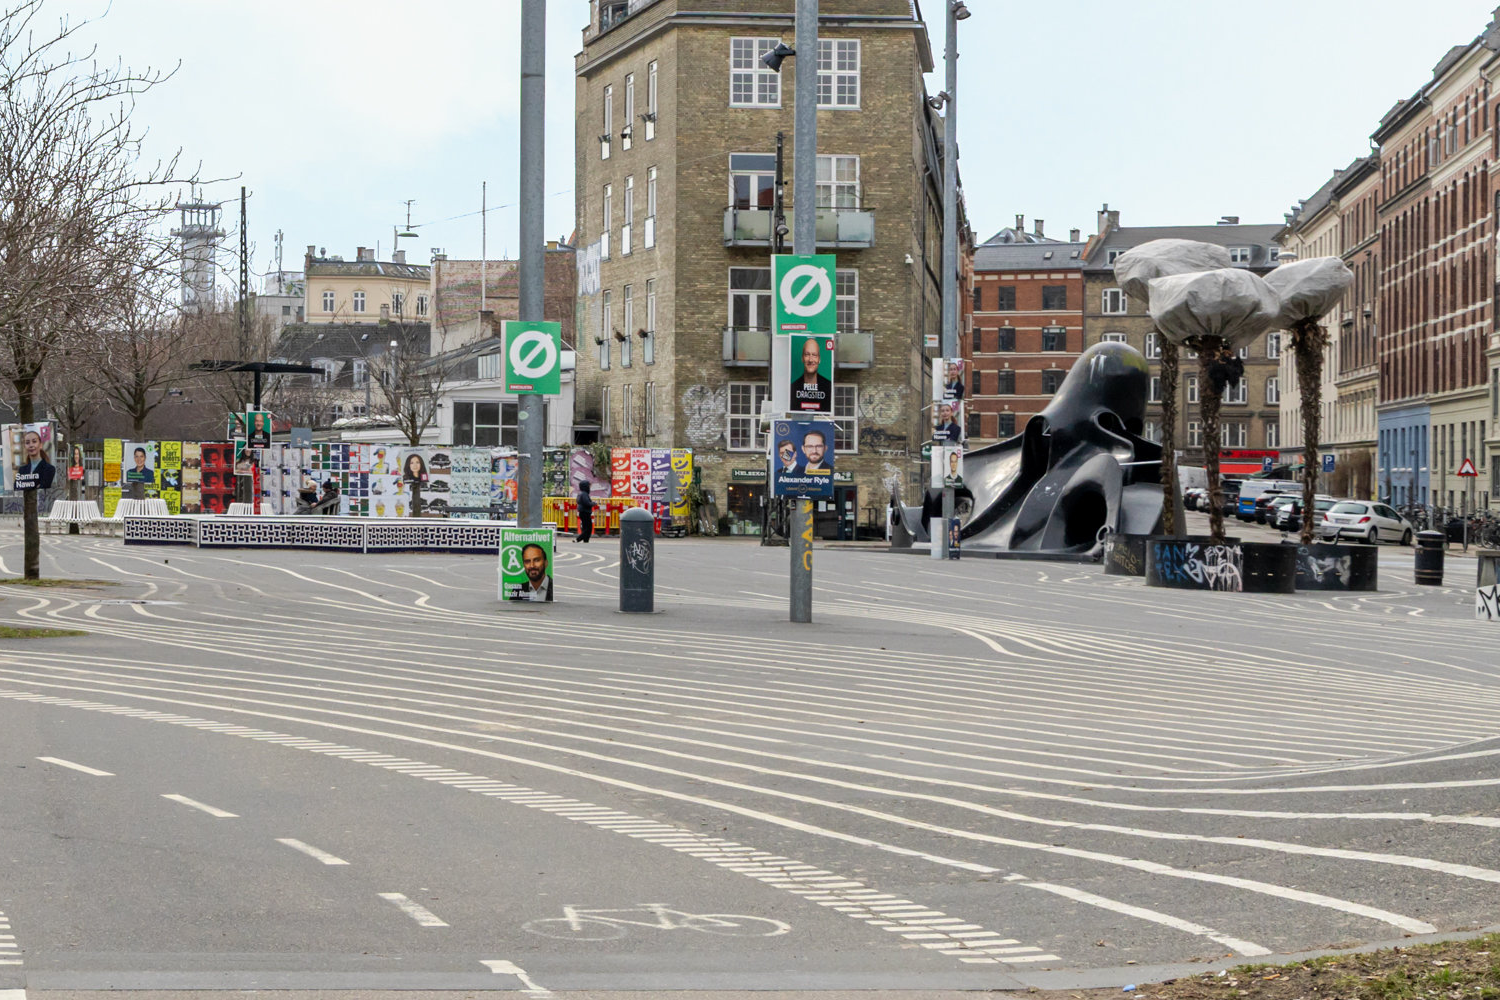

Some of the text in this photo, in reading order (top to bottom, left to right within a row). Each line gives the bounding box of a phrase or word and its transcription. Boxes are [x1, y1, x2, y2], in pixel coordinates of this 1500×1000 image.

[803, 383, 818, 391] PELLE
[796, 390, 826, 400] DRAGSTED
[40, 426, 51, 442] B
[1265, 457, 1272, 465] P
[1325, 455, 1333, 465] P
[15, 480, 36, 489] Nawa
[778, 476, 813, 484] Alexander
[813, 476, 830, 485] Ryle
[503, 531, 551, 542] Alternativet
